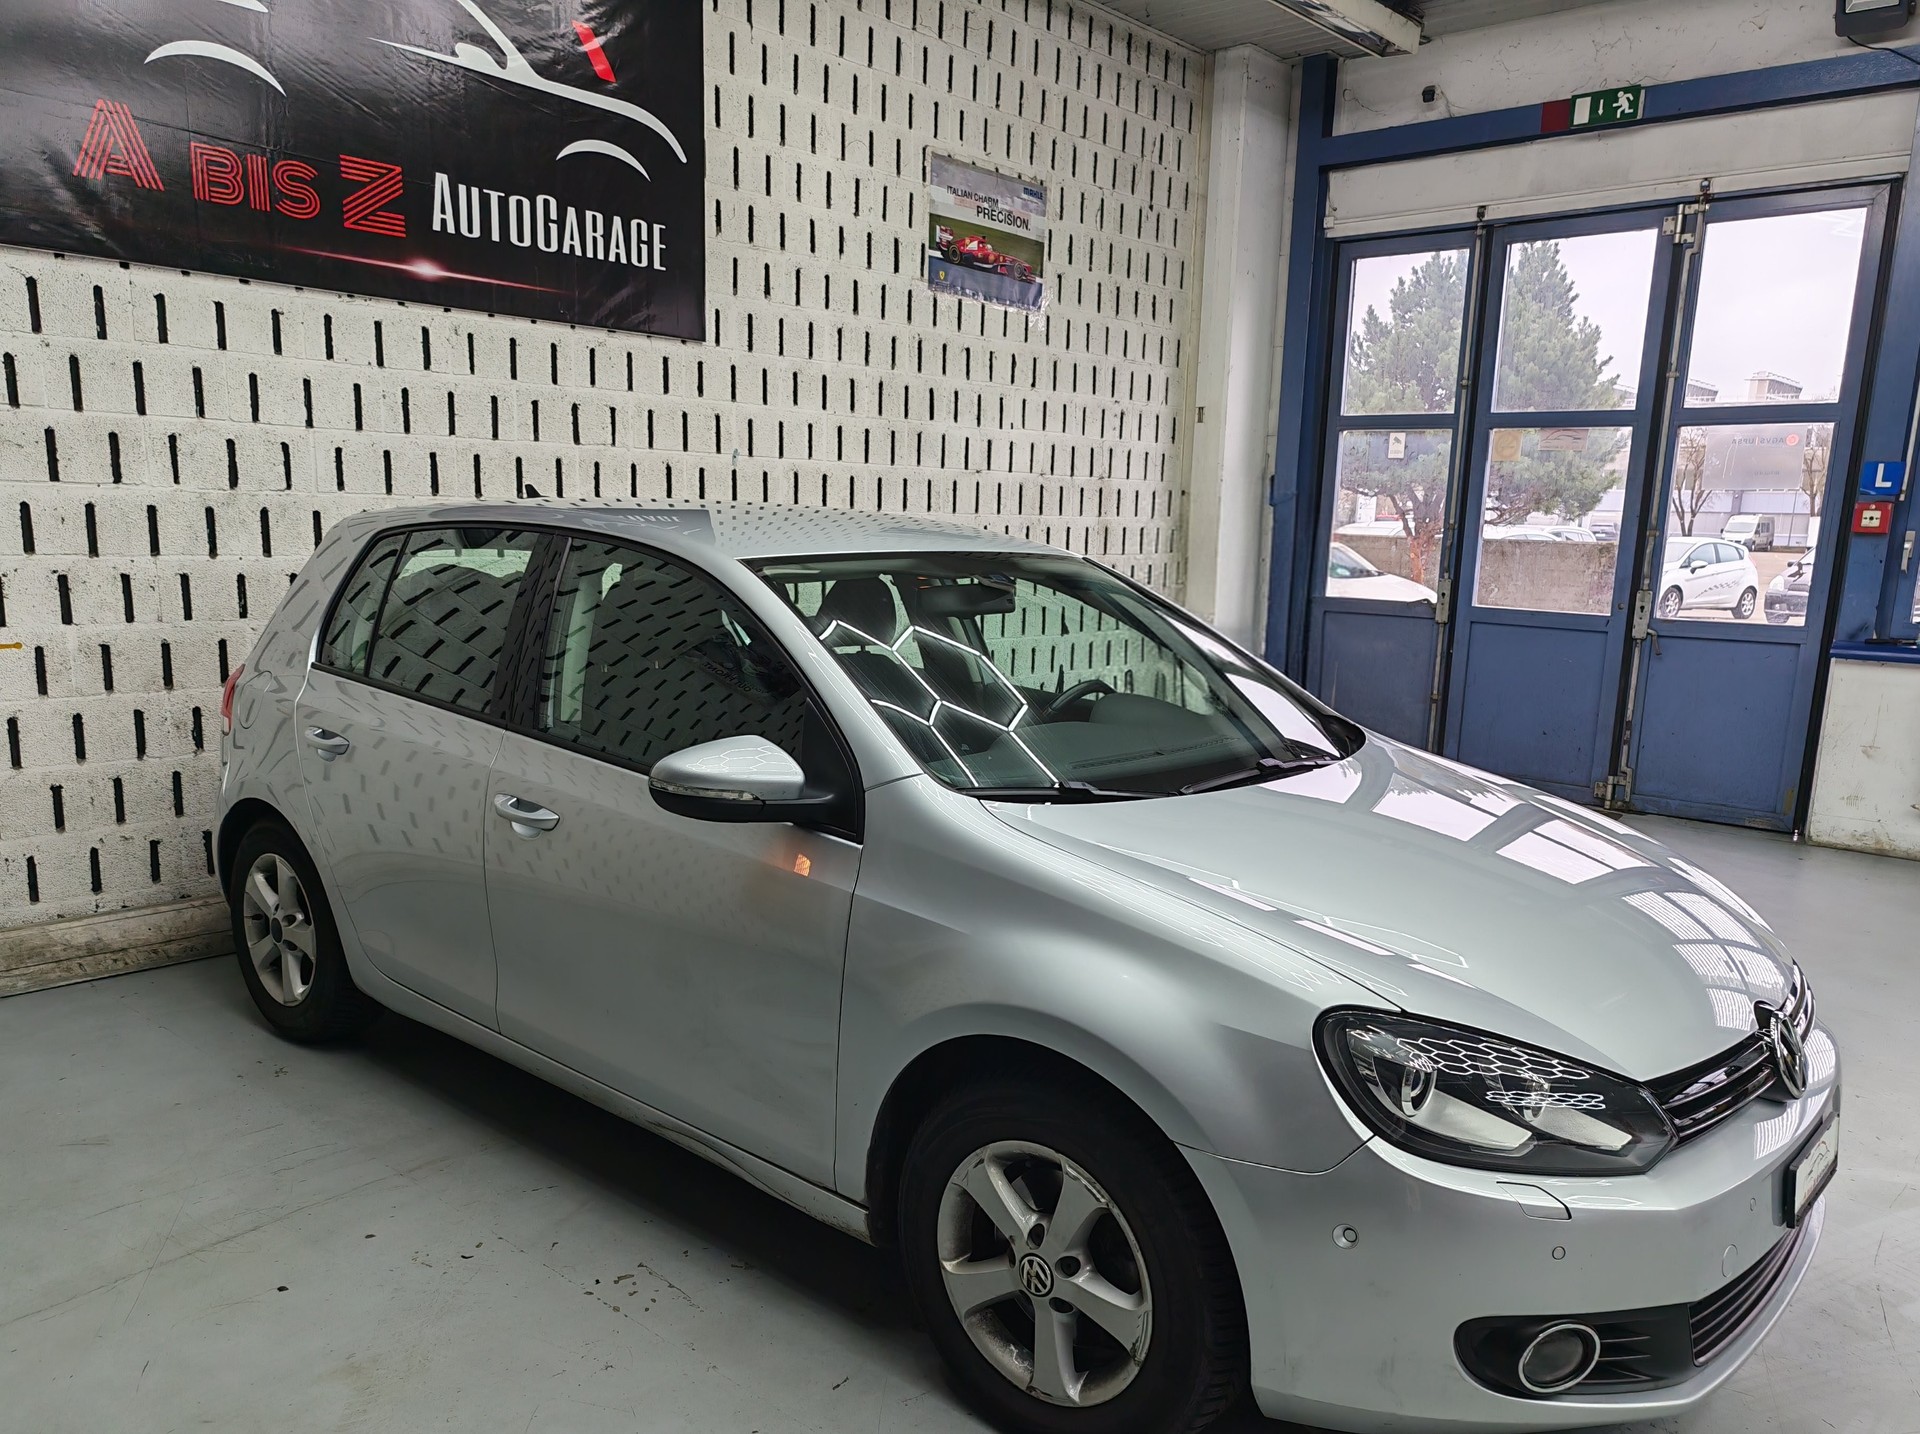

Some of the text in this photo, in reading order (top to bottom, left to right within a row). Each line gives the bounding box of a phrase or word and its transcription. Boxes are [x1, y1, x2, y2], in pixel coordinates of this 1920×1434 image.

[72, 98, 165, 192] A
[189, 141, 322, 220] BIS
[338, 153, 407, 238] Z
[946, 185, 973, 201] ITALIAN
[1023, 186, 1044, 201] MAHLE
[976, 205, 1032, 231] PRECISION.
[1874, 462, 1893, 488] L
